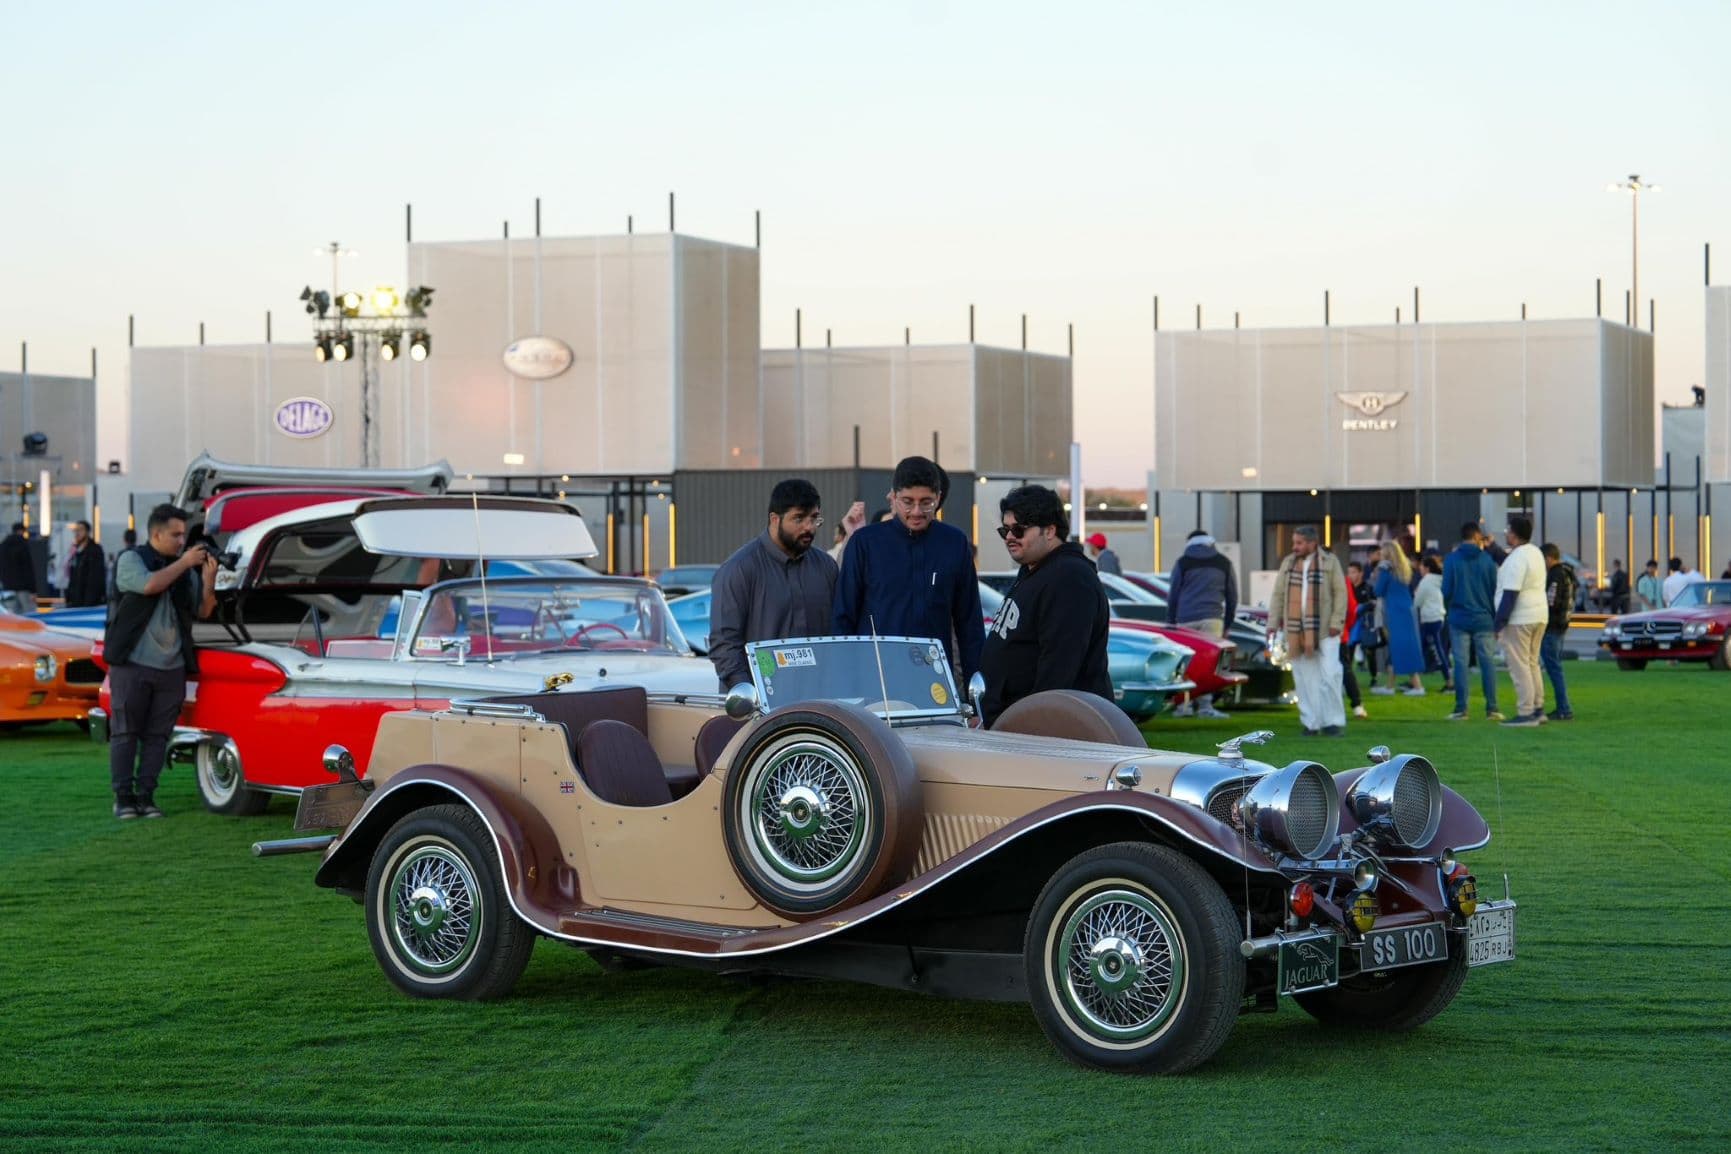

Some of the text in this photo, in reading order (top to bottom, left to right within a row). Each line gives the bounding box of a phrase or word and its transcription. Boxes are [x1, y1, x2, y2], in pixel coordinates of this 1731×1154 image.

[1342, 419, 1397, 431] BENTLEY
[784, 648, 813, 661] mj.981
[1373, 928, 1436, 965] SS 100
[1469, 941, 1490, 962] 4825
[1284, 963, 1328, 991] JAGUAR
